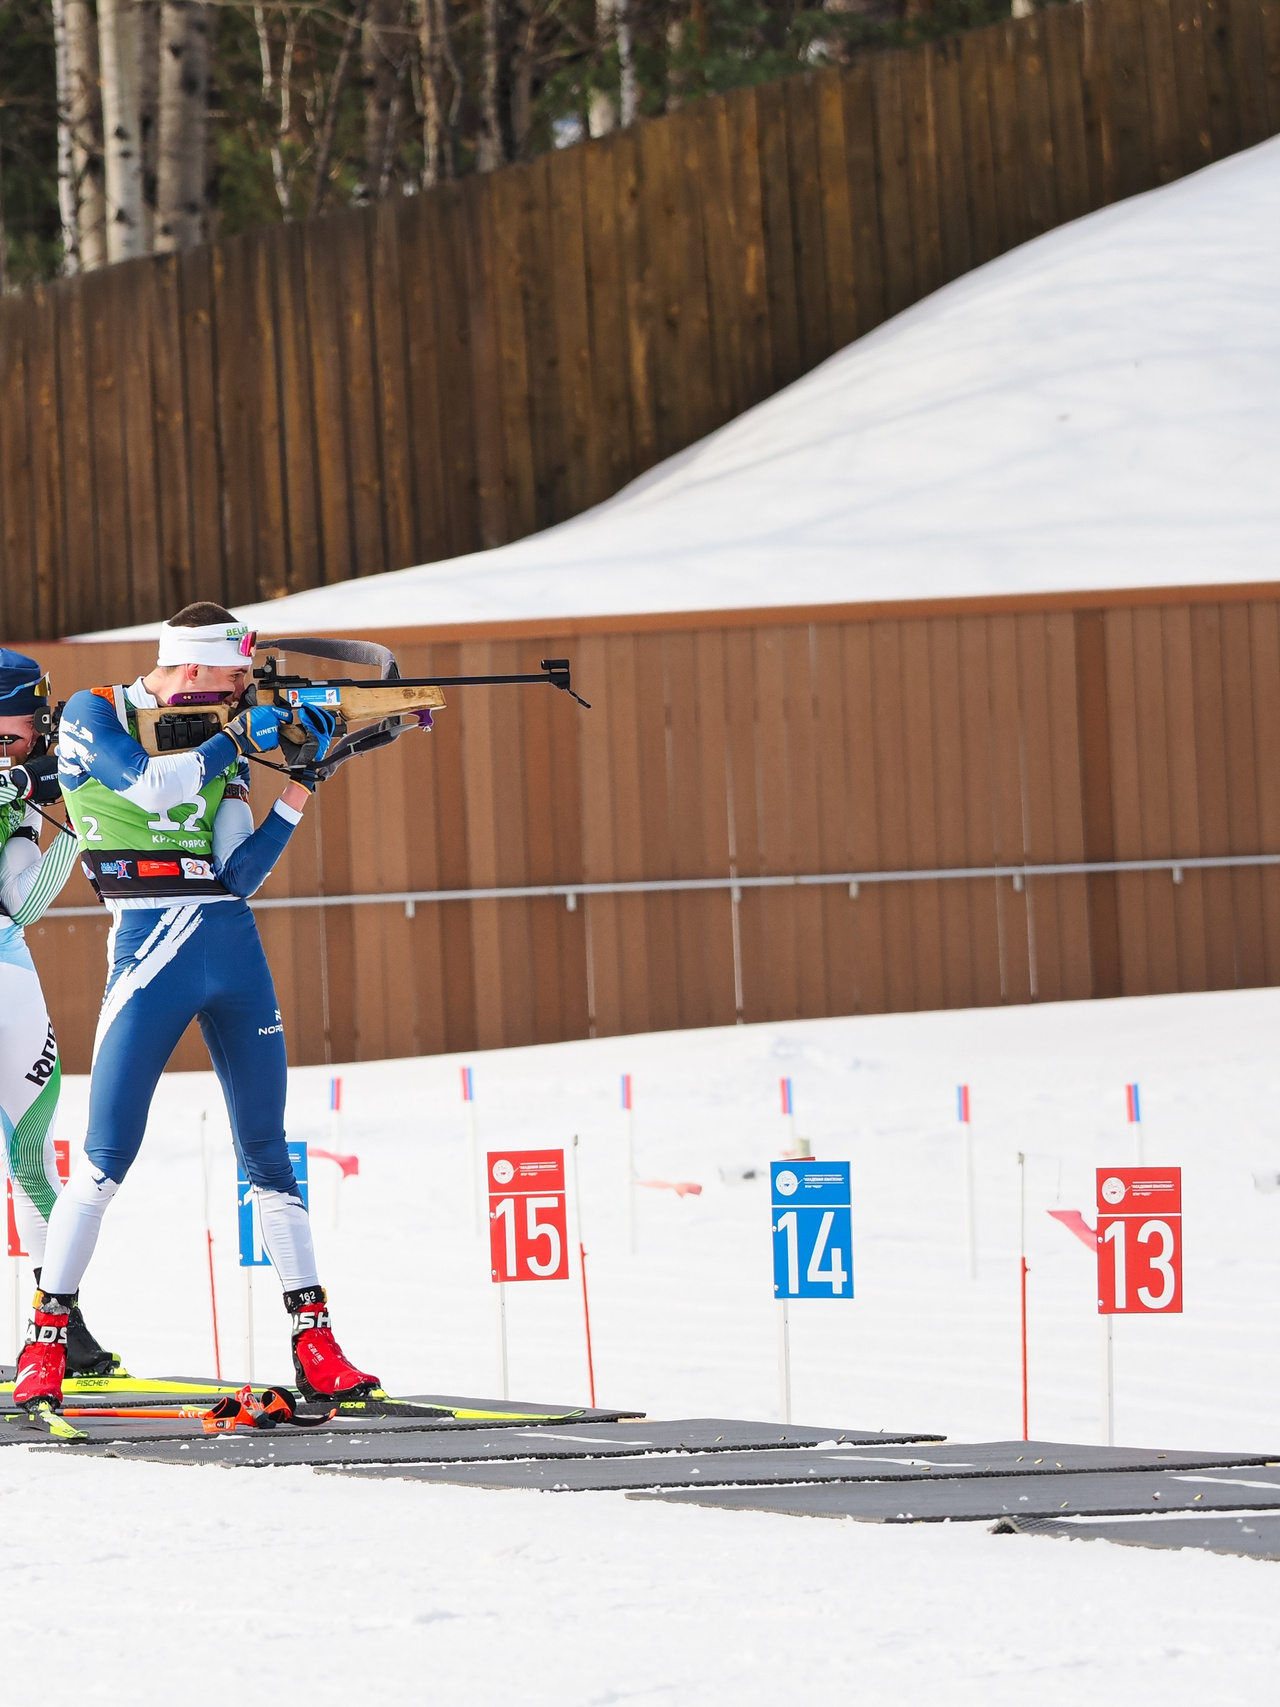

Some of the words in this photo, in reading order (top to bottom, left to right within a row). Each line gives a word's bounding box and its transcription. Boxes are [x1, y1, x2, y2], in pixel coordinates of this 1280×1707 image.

[495, 1196, 562, 1278] 15
[777, 1211, 848, 1295] 14
[1104, 1219, 1176, 1310] 13
[299, 1290, 317, 1303] 162
[75, 1379, 110, 1387] FISCHER
[340, 1401, 366, 1409] FISCHER
